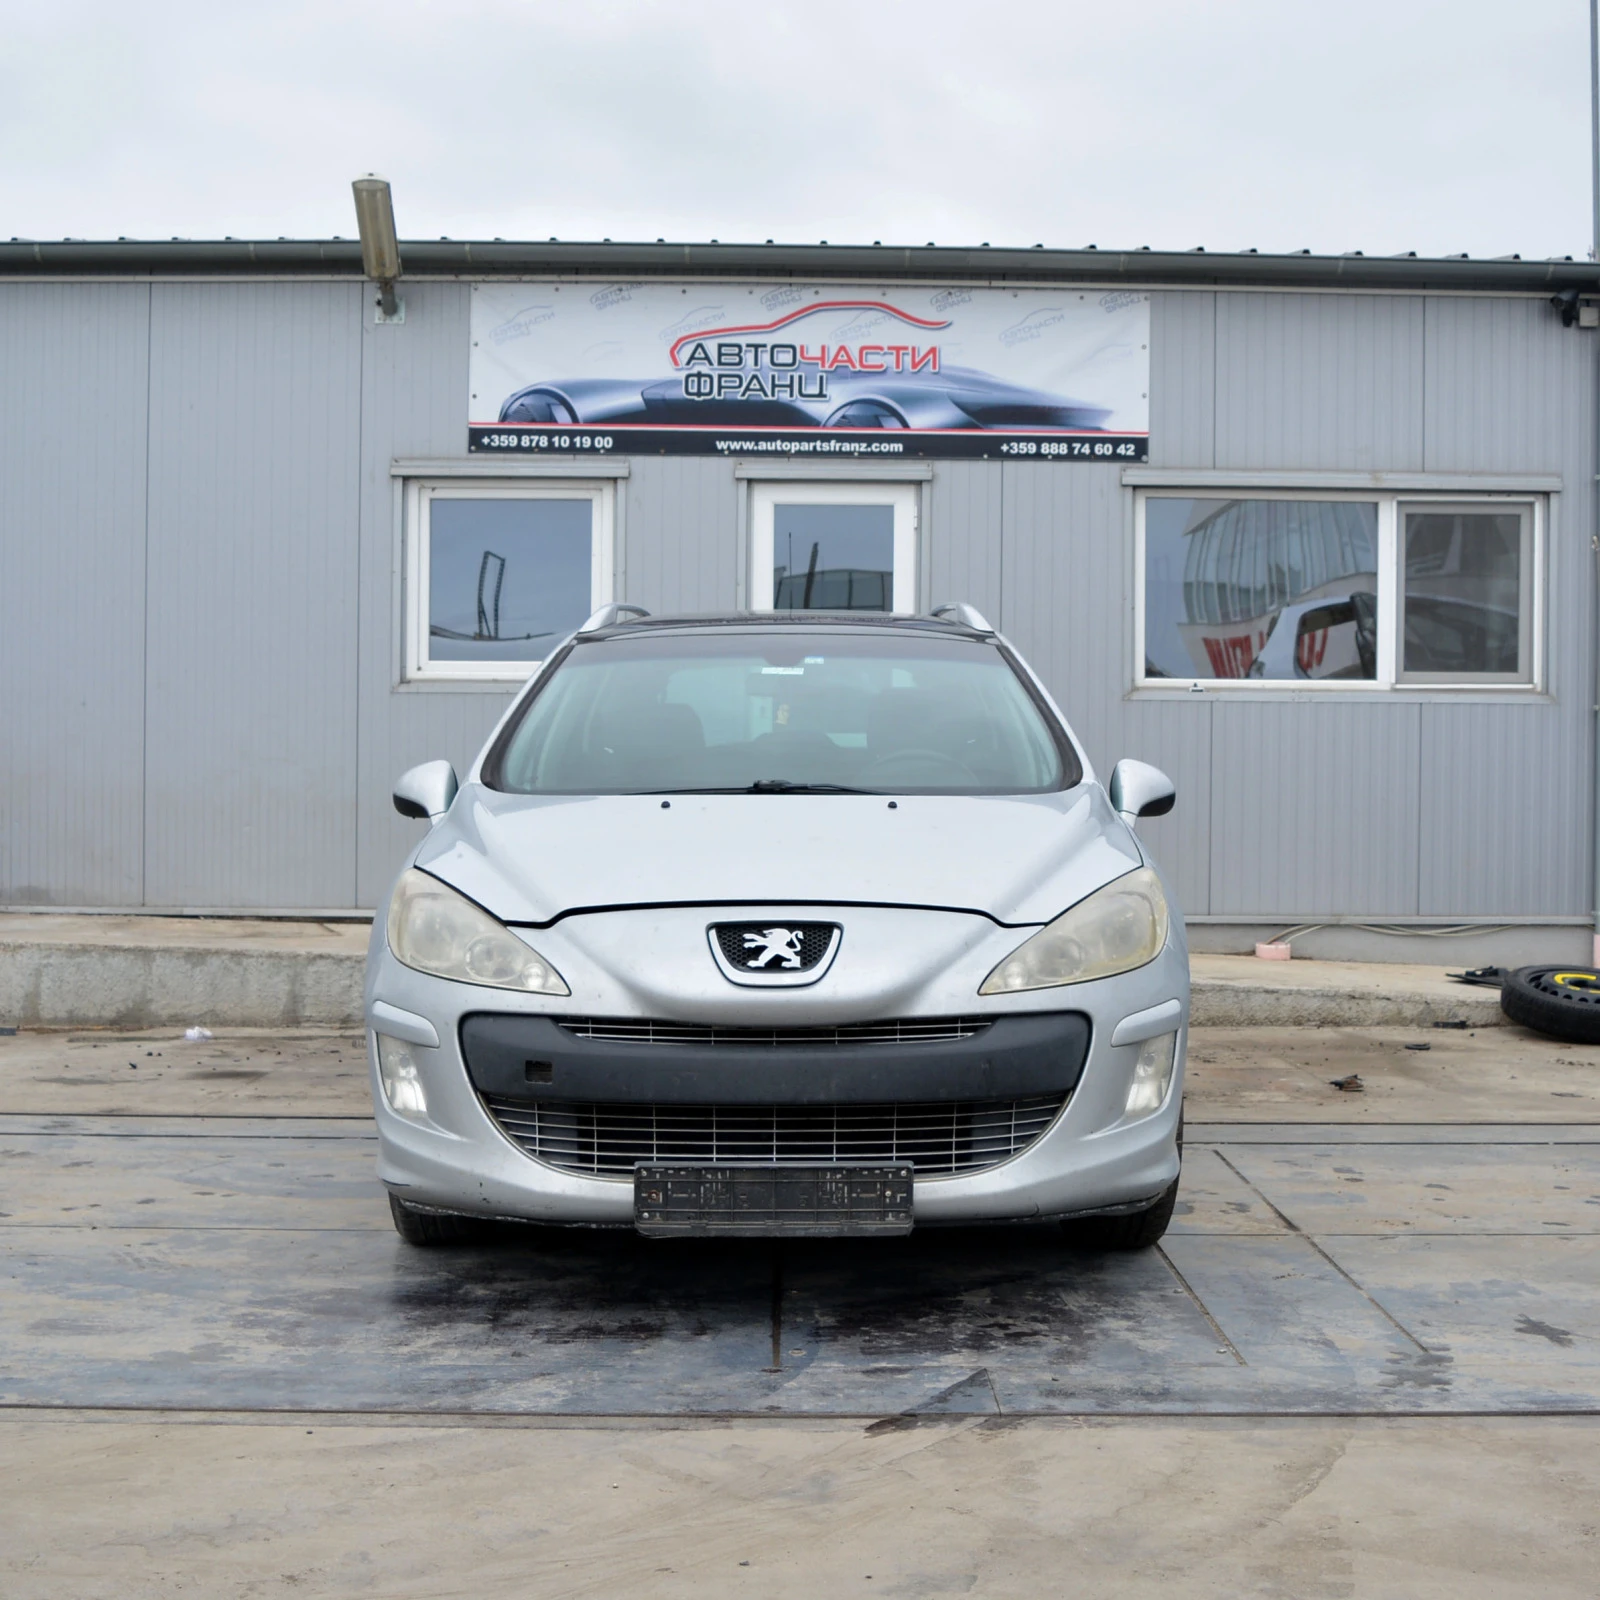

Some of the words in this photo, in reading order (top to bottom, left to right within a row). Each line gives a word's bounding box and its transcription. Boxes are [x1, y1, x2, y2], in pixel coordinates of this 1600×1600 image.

[684, 342, 938, 371] АВТОЧАСТИ
[684, 370, 828, 400] ФРАНЦ
[481, 434, 518, 448] +359
[520, 434, 549, 448] 878
[551, 435, 570, 449] 10
[573, 435, 592, 449] 19
[594, 436, 614, 449] 00
[715, 438, 904, 454] www.autopartsfranz.com
[1000, 442, 1037, 455] +359
[1040, 442, 1069, 455] 888
[1071, 442, 1091, 456] 74
[1093, 443, 1113, 456] 60
[1116, 443, 1136, 456] 42
